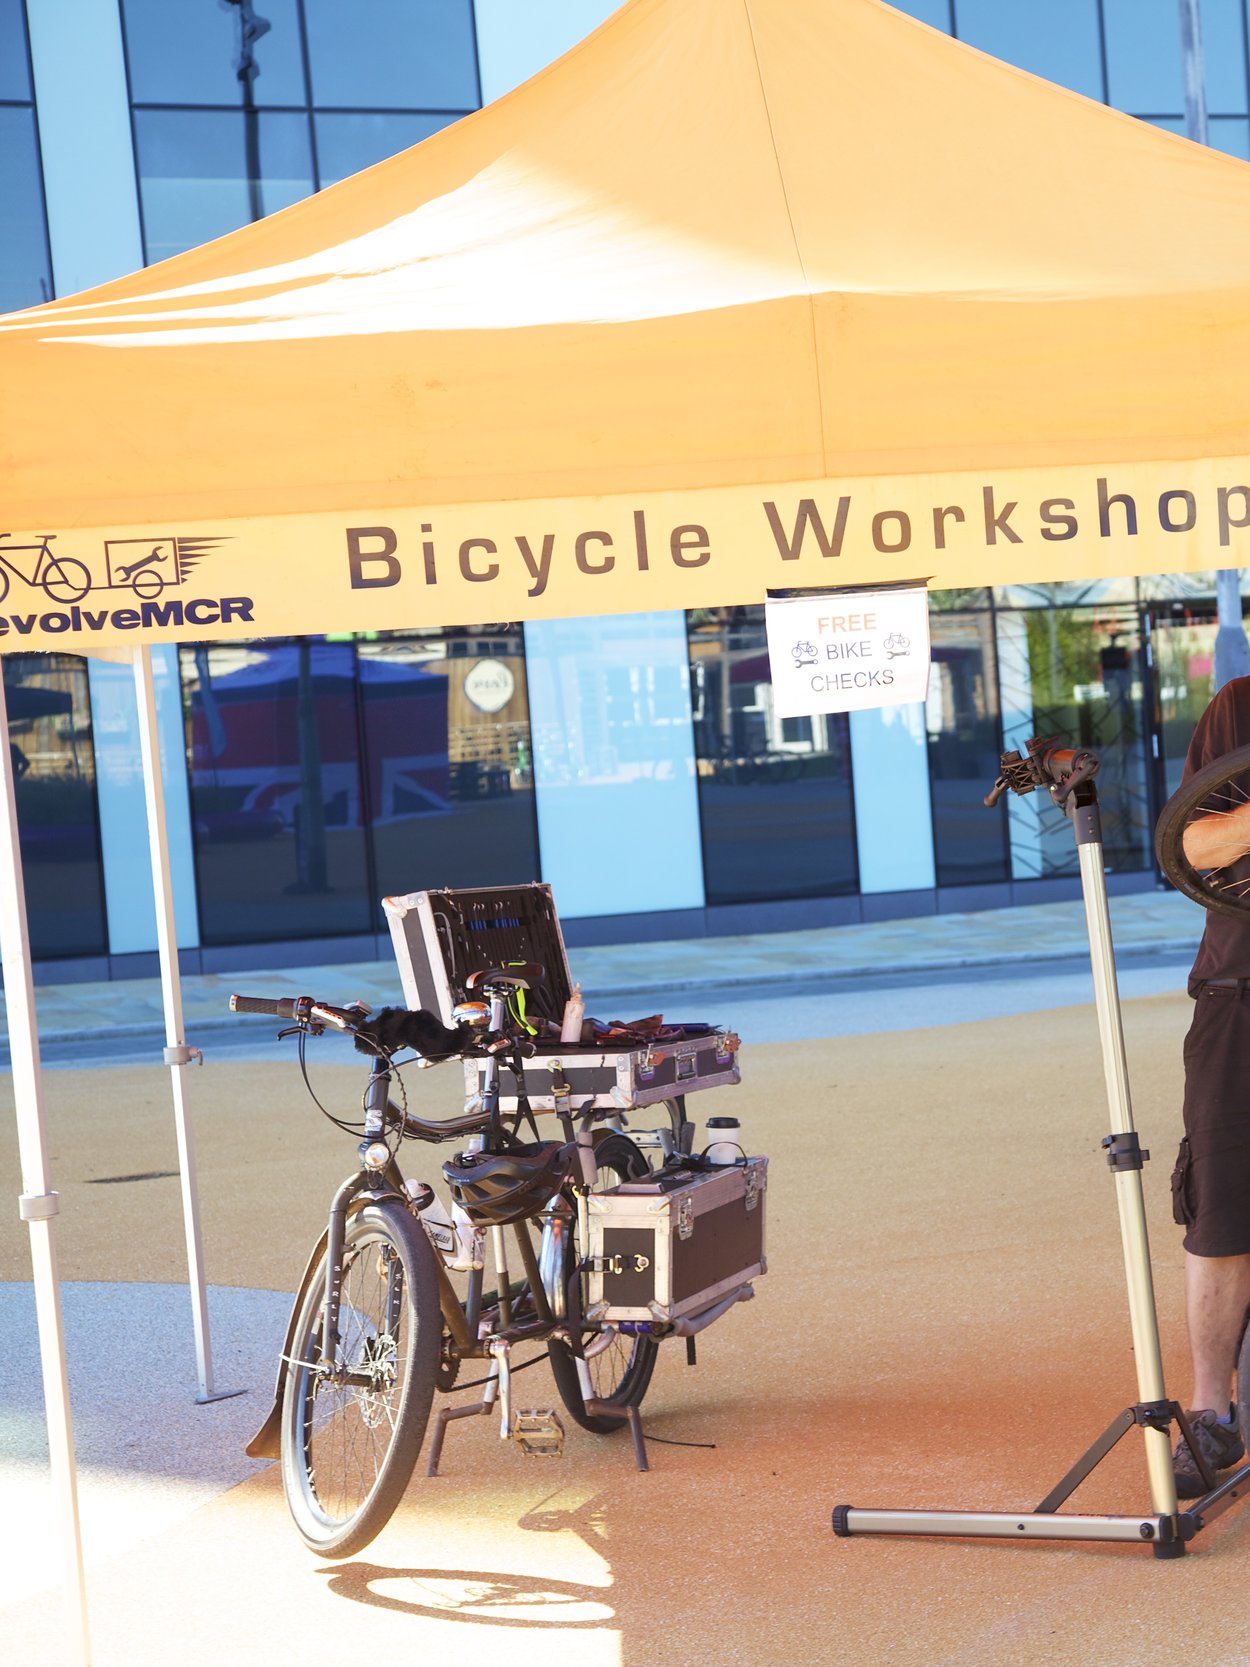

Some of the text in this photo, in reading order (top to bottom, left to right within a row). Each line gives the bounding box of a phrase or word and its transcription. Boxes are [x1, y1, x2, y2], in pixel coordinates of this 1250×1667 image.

[345, 509, 712, 598] Bicycle
[817, 612, 878, 635] FREE
[825, 640, 873, 660] BIKE
[810, 669, 895, 693] CHECKS
